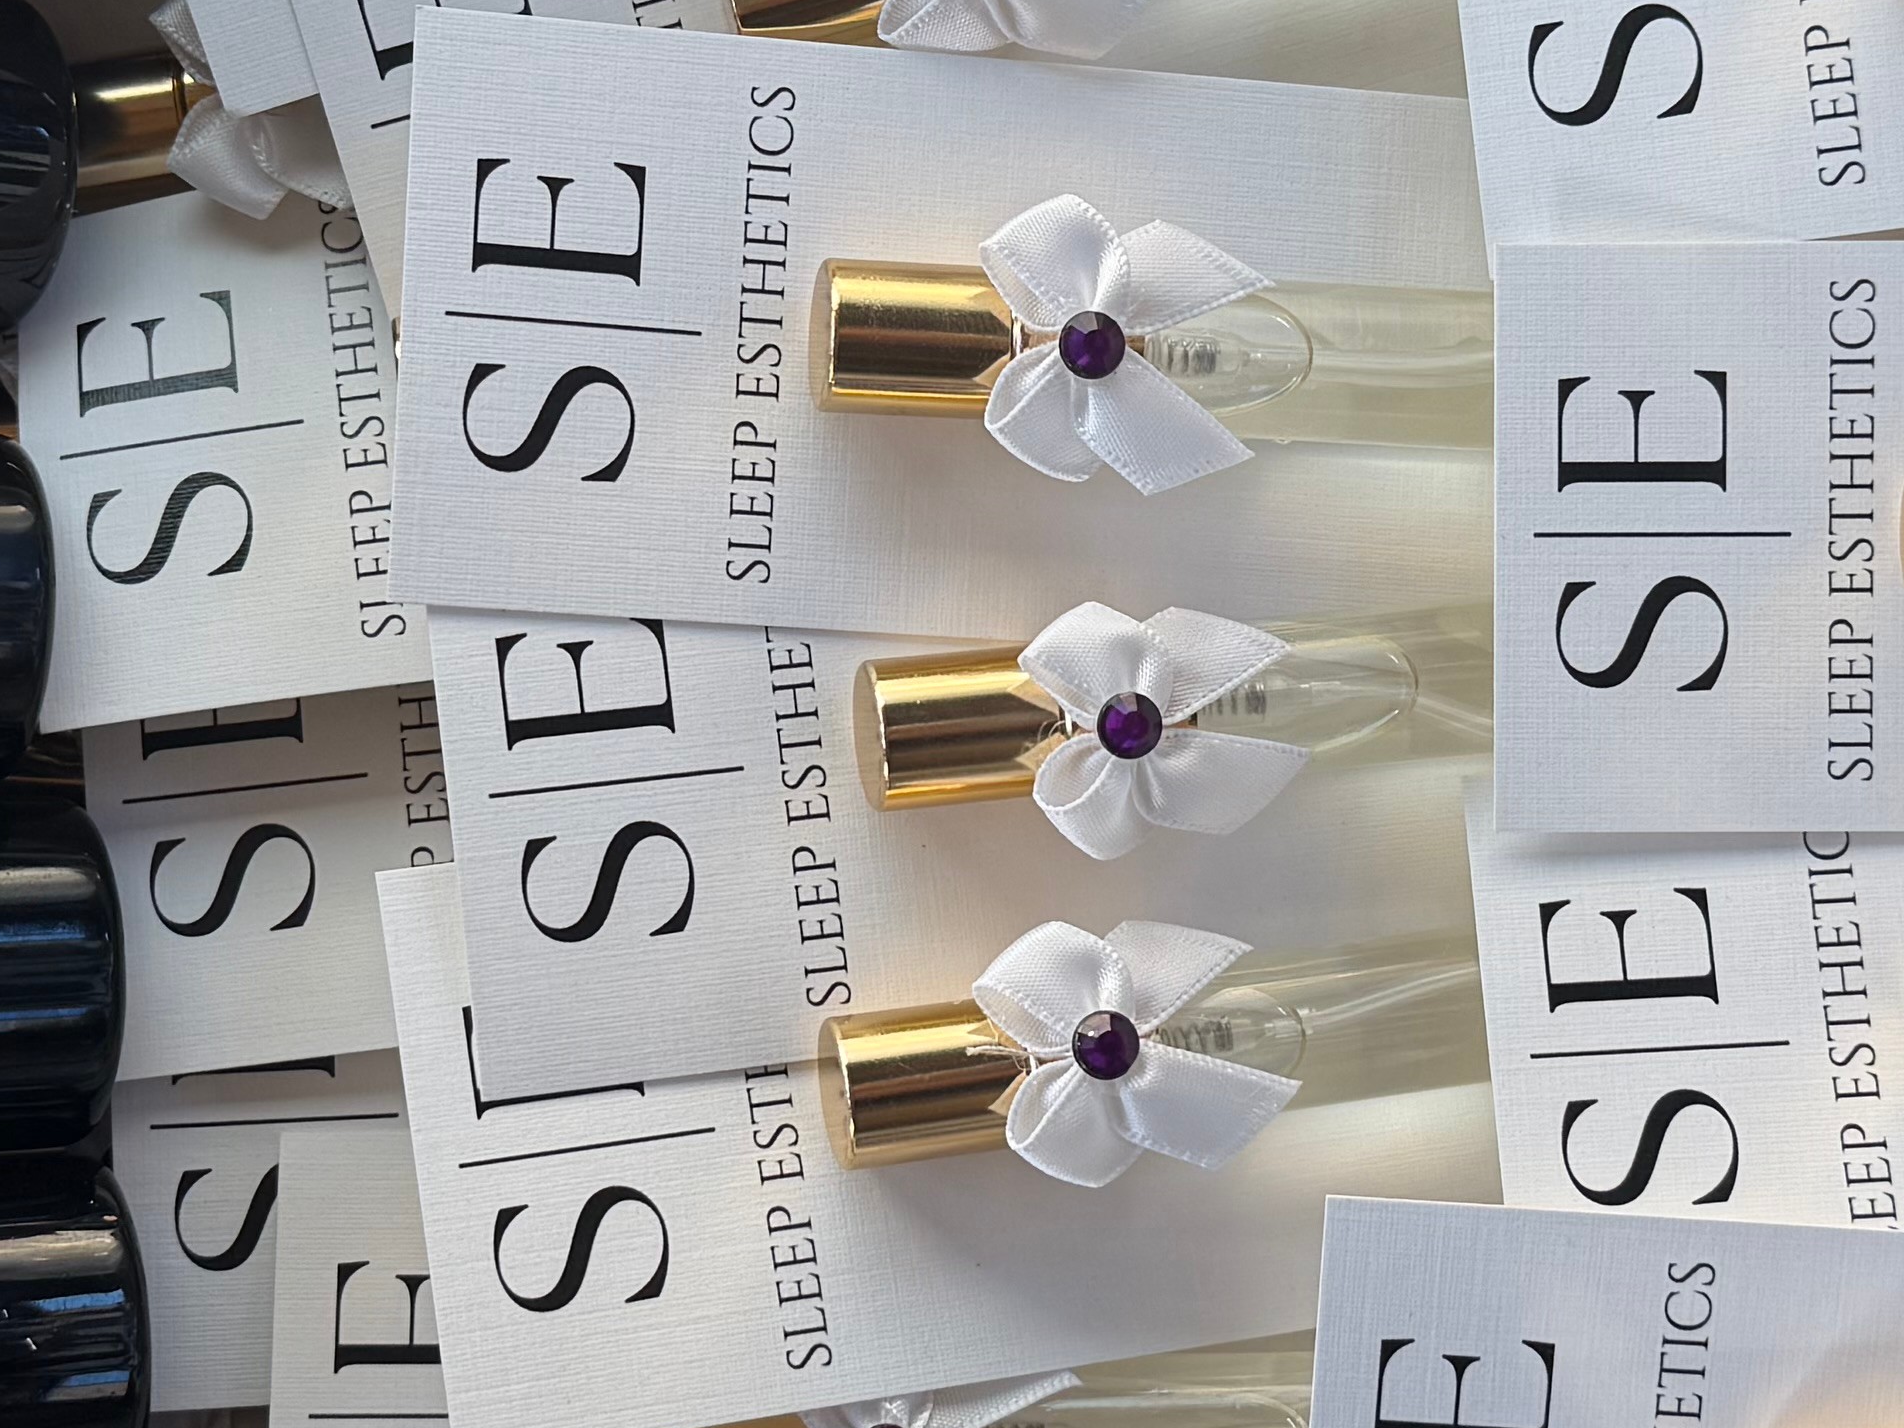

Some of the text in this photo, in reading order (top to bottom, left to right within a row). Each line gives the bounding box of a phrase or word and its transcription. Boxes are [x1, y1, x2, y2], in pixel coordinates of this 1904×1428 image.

[1803, 24, 1867, 187] SLEEP
[725, 84, 797, 584] SLEEP ESTHETICS
[1826, 277, 1878, 783] SLEEP ESTHETICS
[763, 626, 853, 1007] SLEEP ESTHE
[1802, 830, 1900, 1231] EEP ESTHETIC
[765, 1205, 834, 1370] SLEEP
